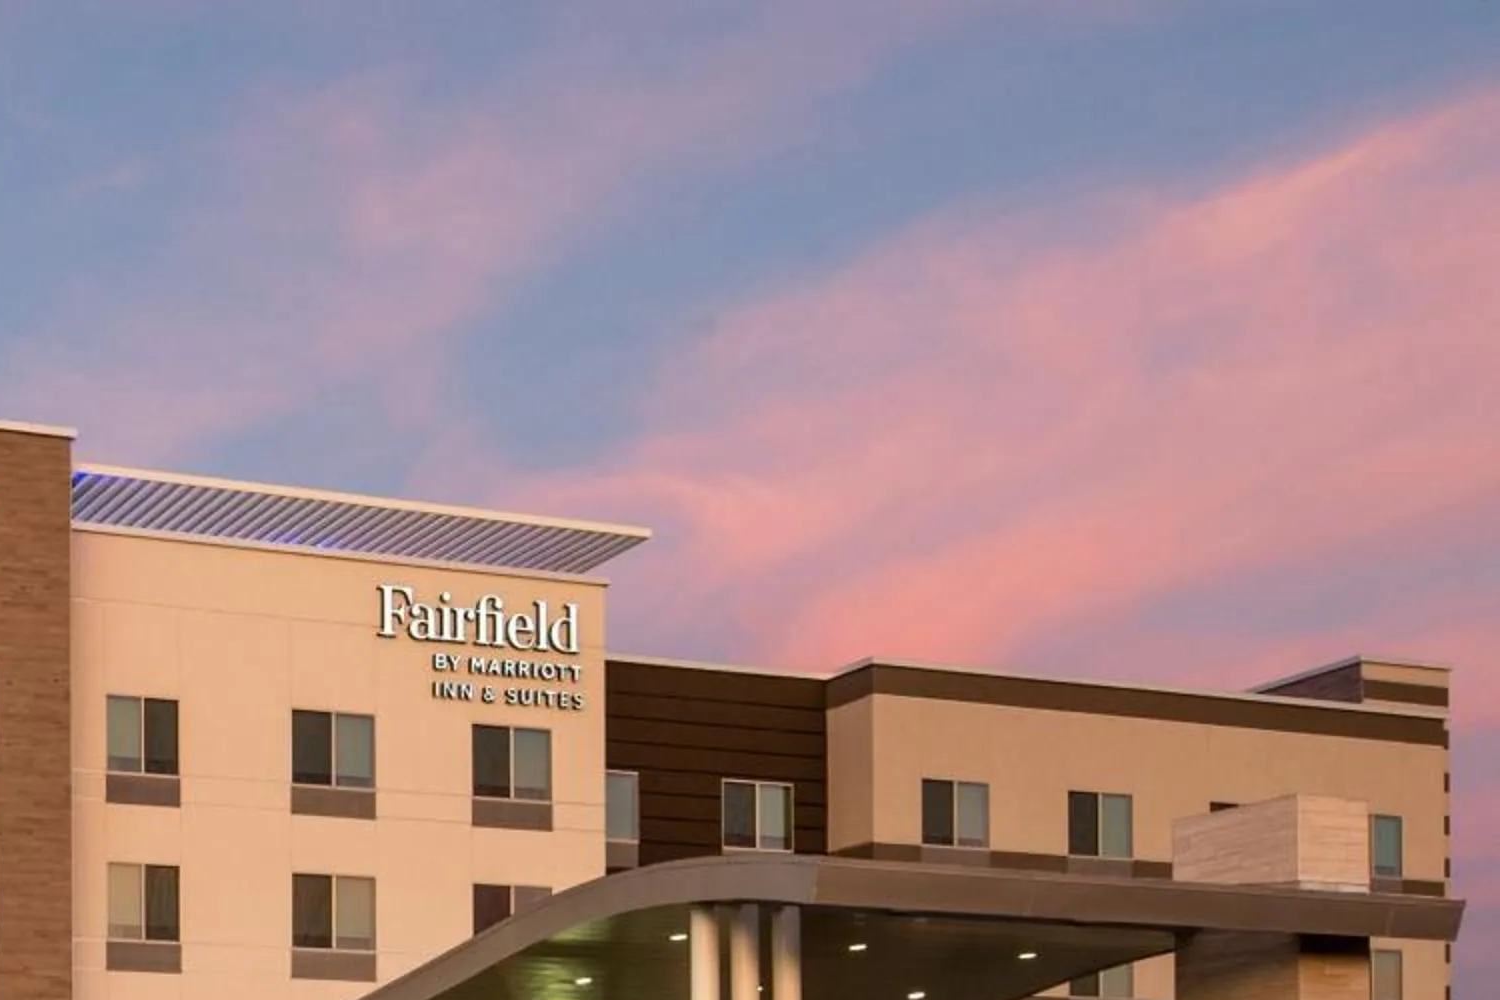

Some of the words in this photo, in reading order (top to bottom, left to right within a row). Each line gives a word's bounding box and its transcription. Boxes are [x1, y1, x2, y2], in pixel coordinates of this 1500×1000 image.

[377, 584, 581, 654] Fairfield
[432, 653, 462, 672] BY
[469, 656, 582, 682] MARRIOTT
[432, 681, 474, 701] INN
[481, 686, 497, 704] &
[504, 686, 585, 711] SUITES
